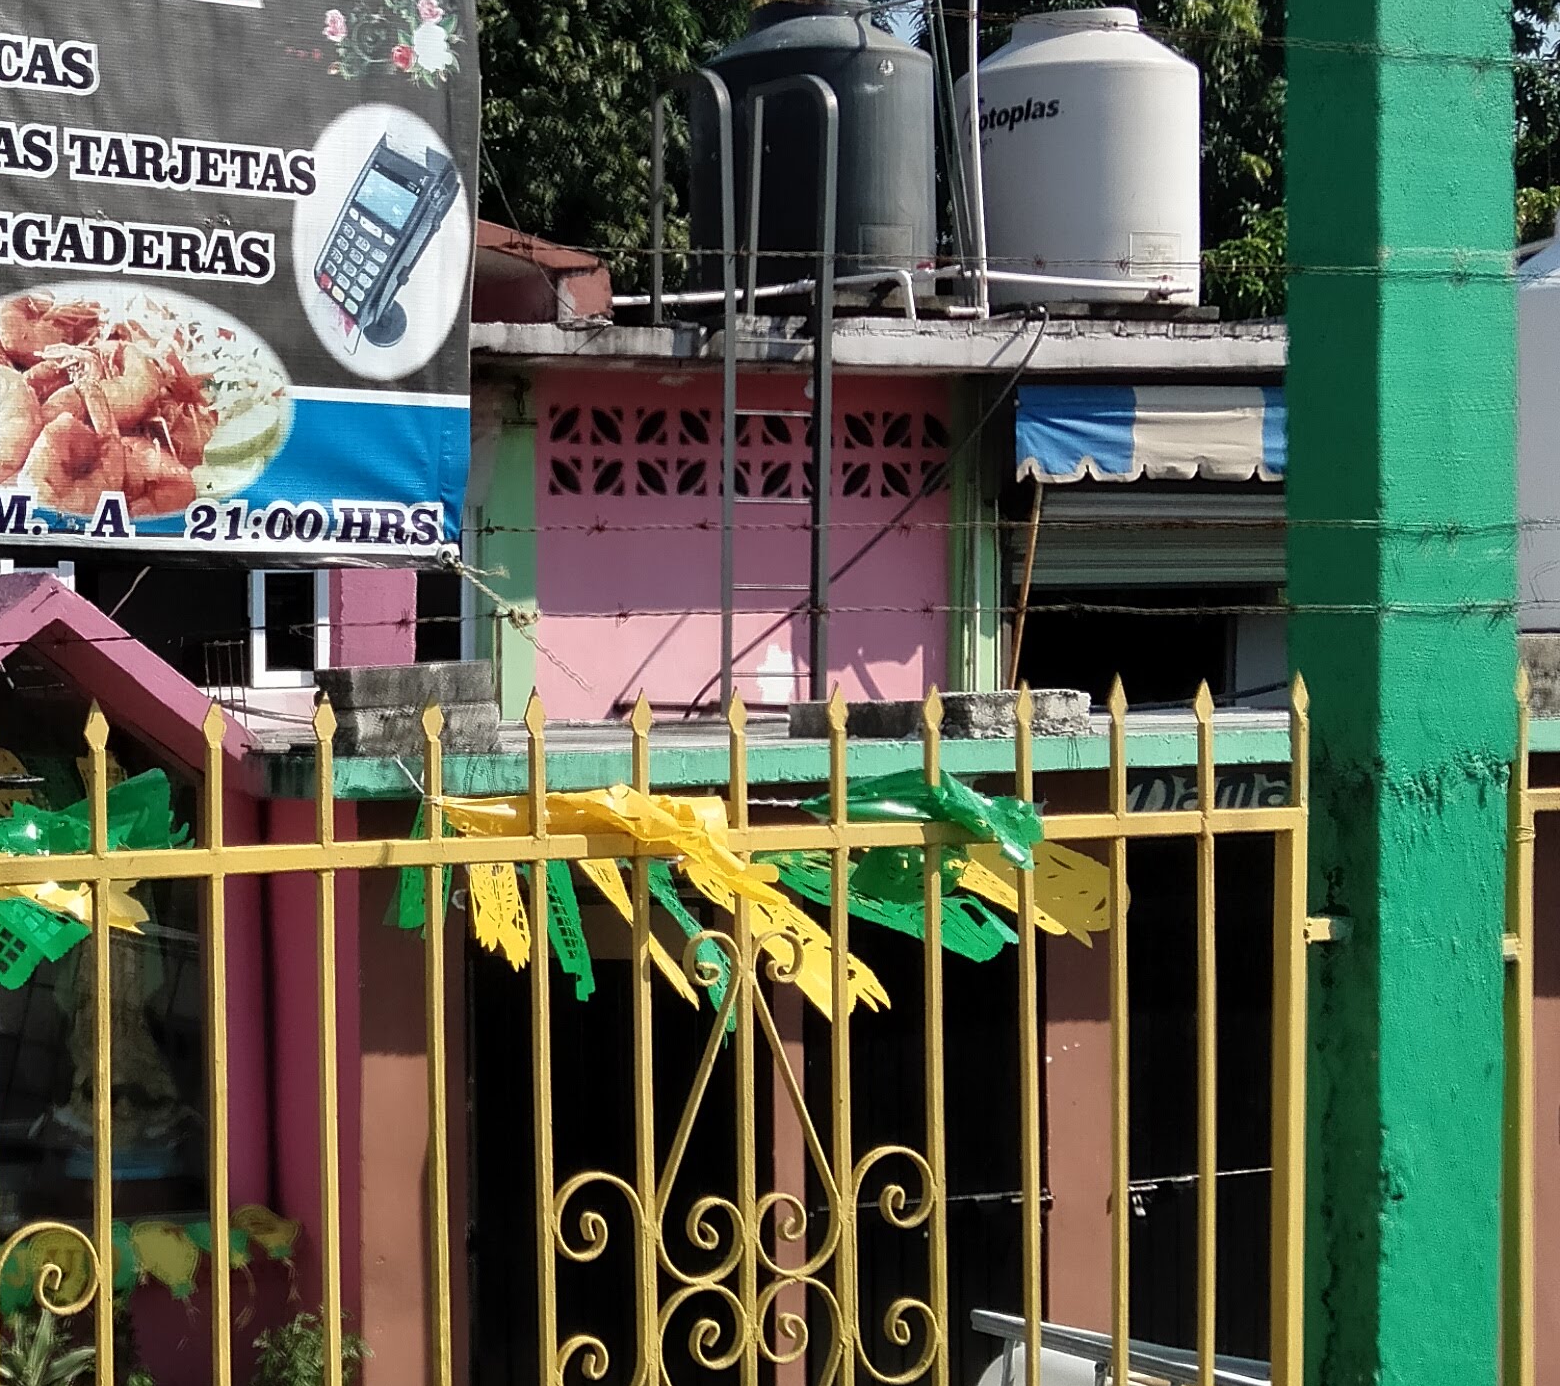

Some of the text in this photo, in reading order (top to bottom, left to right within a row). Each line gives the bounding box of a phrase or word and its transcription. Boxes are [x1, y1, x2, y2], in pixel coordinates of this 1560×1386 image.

[69, 135, 318, 197] TARJETAS
[91, 499, 130, 538] A
[190, 507, 324, 543] 21:00
[336, 509, 439, 545] HRS
